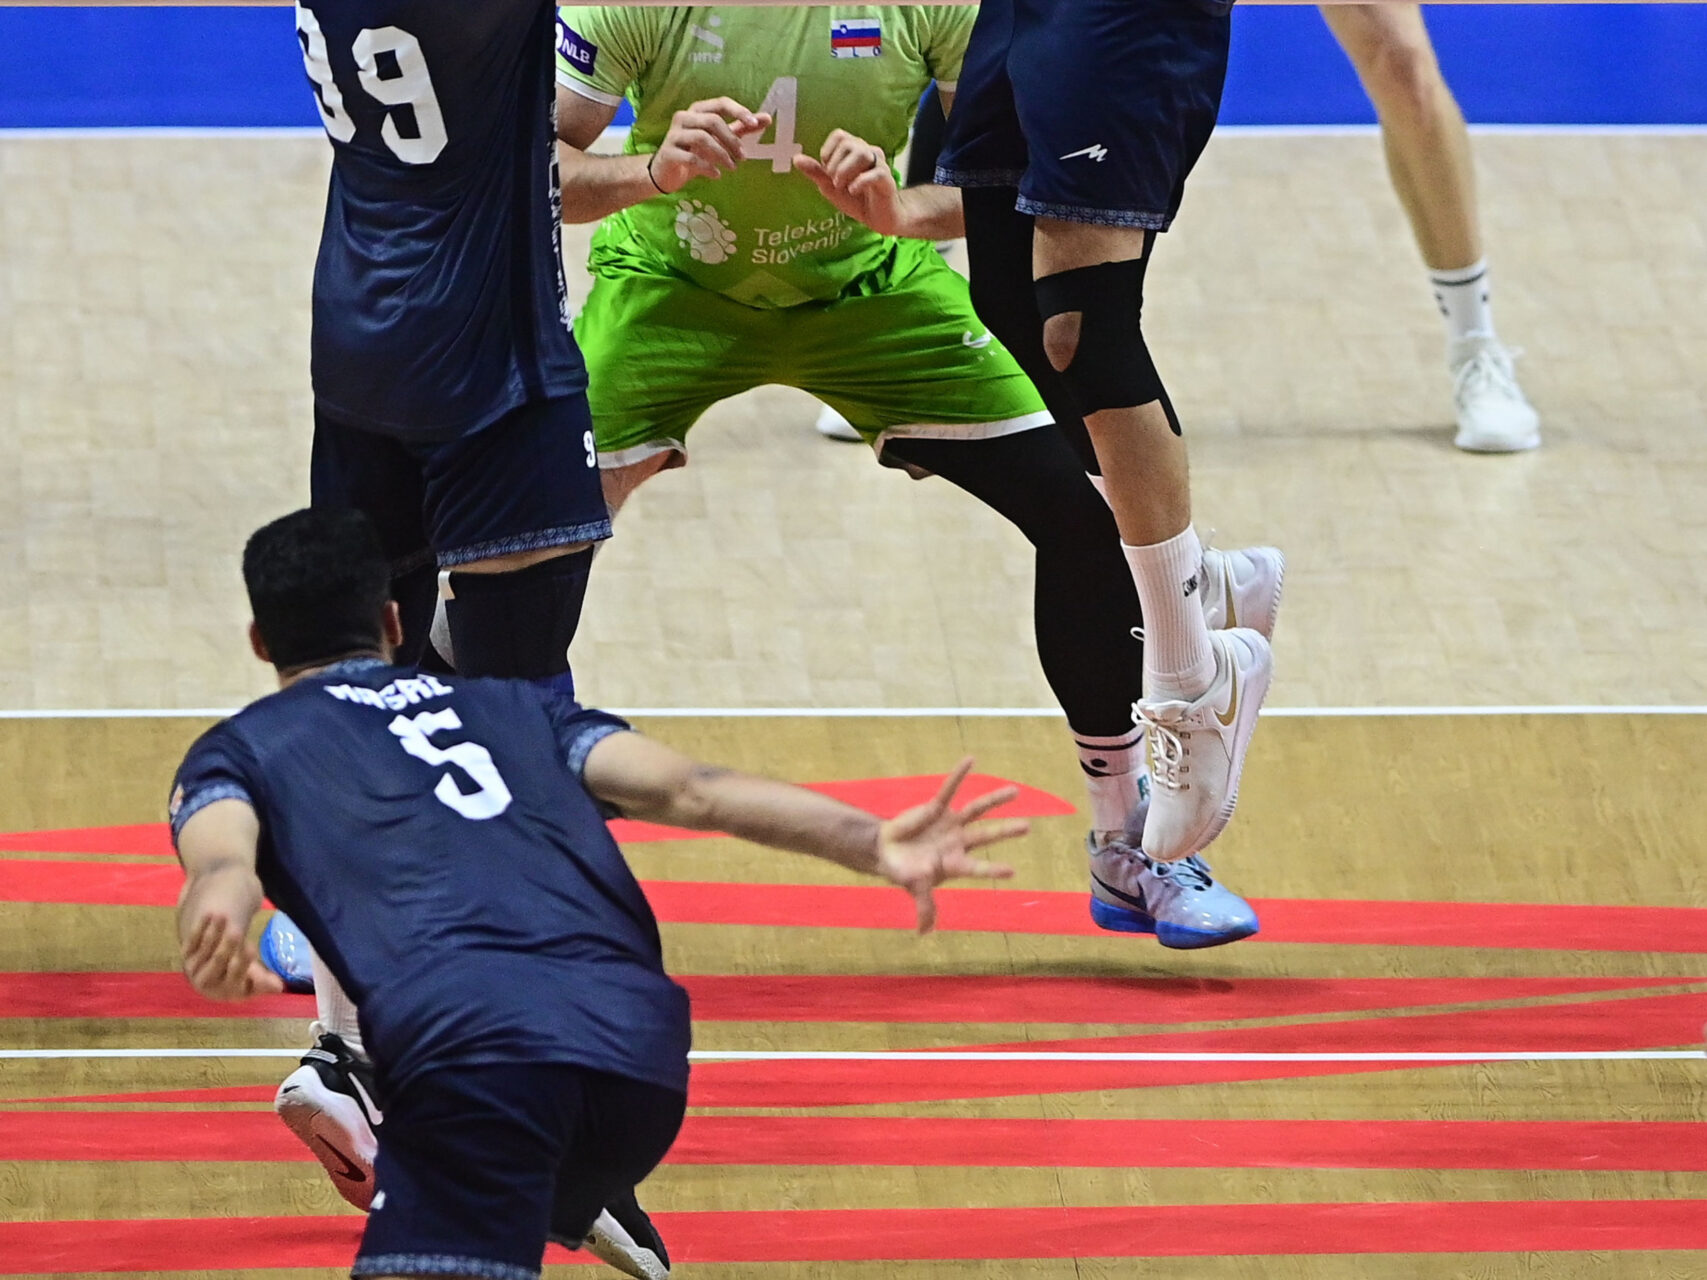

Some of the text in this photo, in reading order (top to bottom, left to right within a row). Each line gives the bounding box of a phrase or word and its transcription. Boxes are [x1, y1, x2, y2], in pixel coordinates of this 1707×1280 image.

[562, 38, 590, 64] NLB
[740, 76, 803, 173] 4
[751, 226, 853, 265] Slovenije
[583, 429, 596, 468] 9
[387, 707, 513, 820] 5
